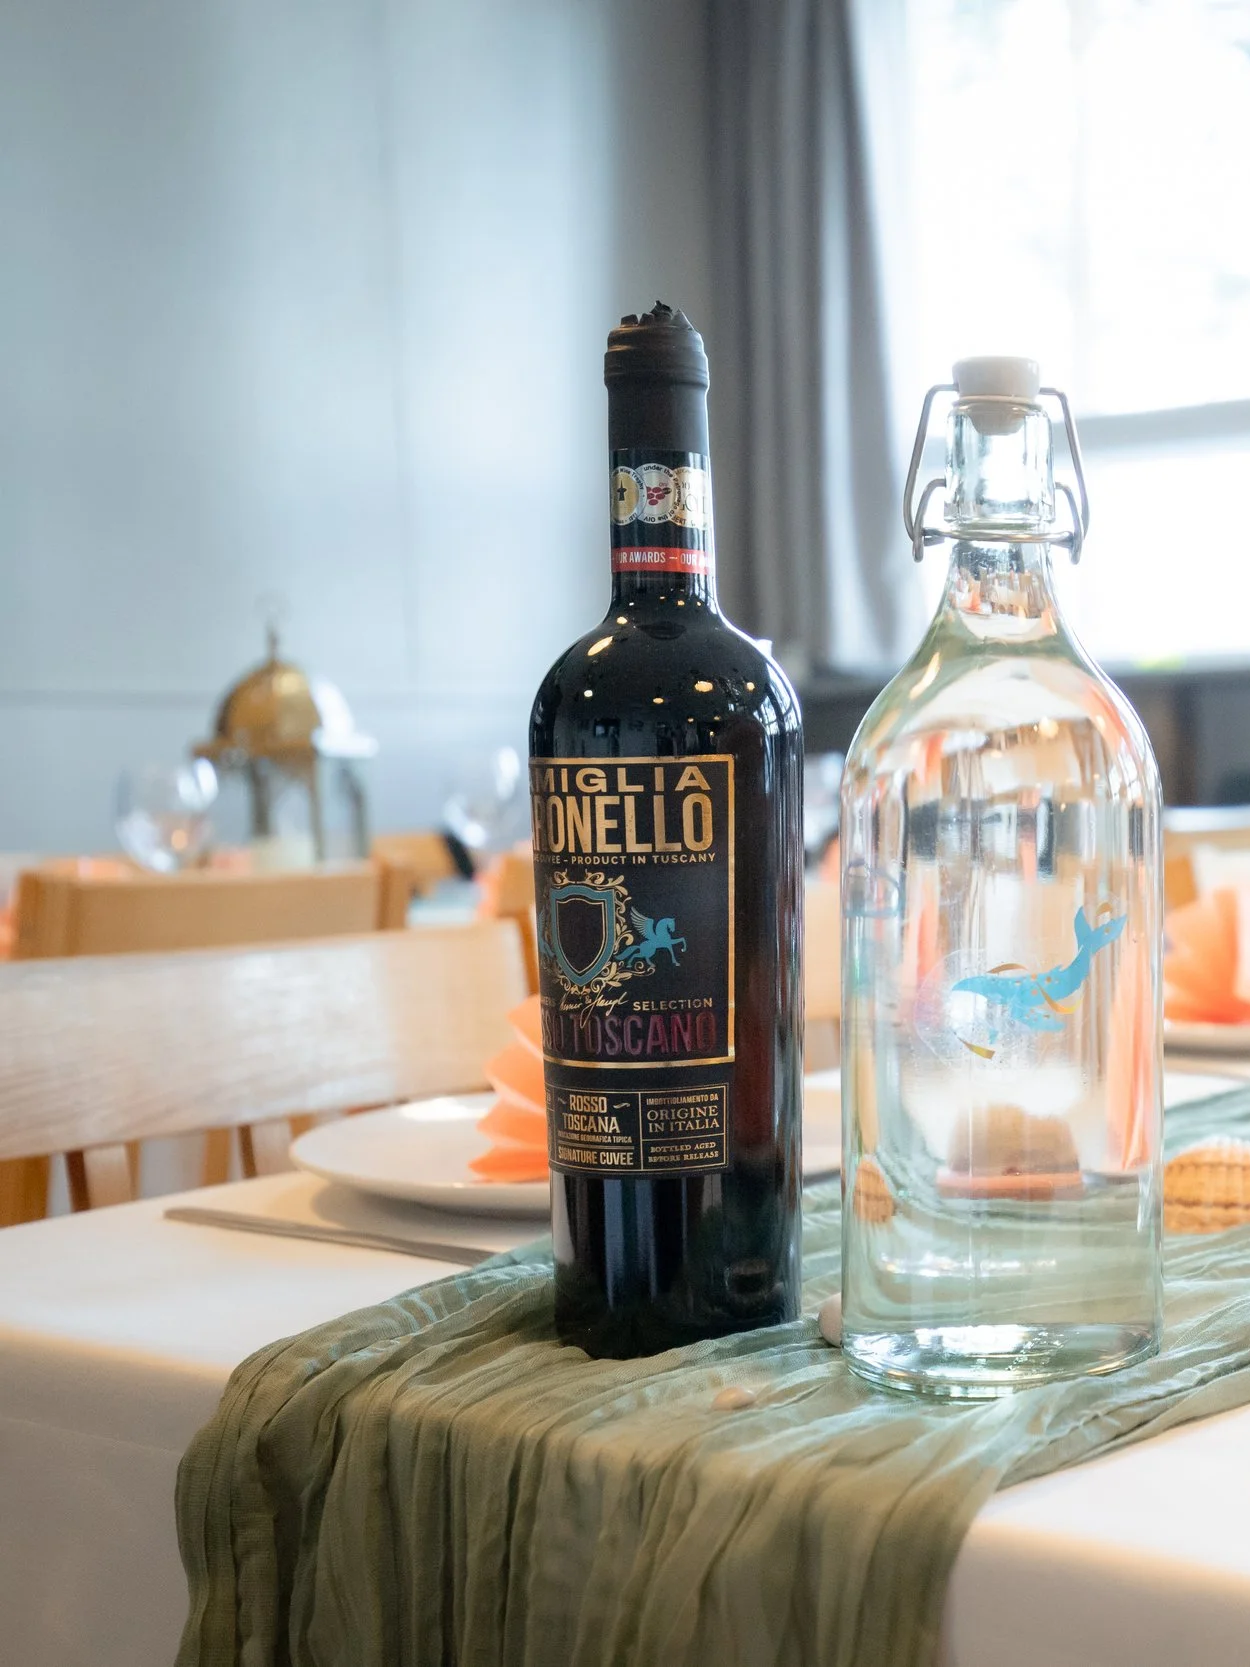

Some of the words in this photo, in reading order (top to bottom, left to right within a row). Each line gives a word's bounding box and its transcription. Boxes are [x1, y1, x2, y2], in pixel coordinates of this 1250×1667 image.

[629, 551, 666, 563] AWARDS
[571, 855, 627, 865] PRODUCT
[632, 855, 646, 864] IN
[652, 852, 716, 864] TUSCANY
[632, 997, 713, 1011] SELECTION
[568, 1010, 717, 1056] TOSCANO
[569, 1094, 608, 1113] ROSSO
[646, 1105, 719, 1121] ORIGINE
[562, 1112, 621, 1134] TOSCANA
[648, 1122, 666, 1133] IN
[669, 1117, 720, 1132] ITALIA
[612, 1135, 632, 1144] TIPICA
[650, 1143, 692, 1153] BOTTLED
[694, 1141, 717, 1150] AGED
[558, 1145, 598, 1165] SIGNATURE
[599, 1151, 634, 1166] CUVEE
[648, 1154, 681, 1163] BEFORE
[683, 1150, 719, 1161] RELEASE
